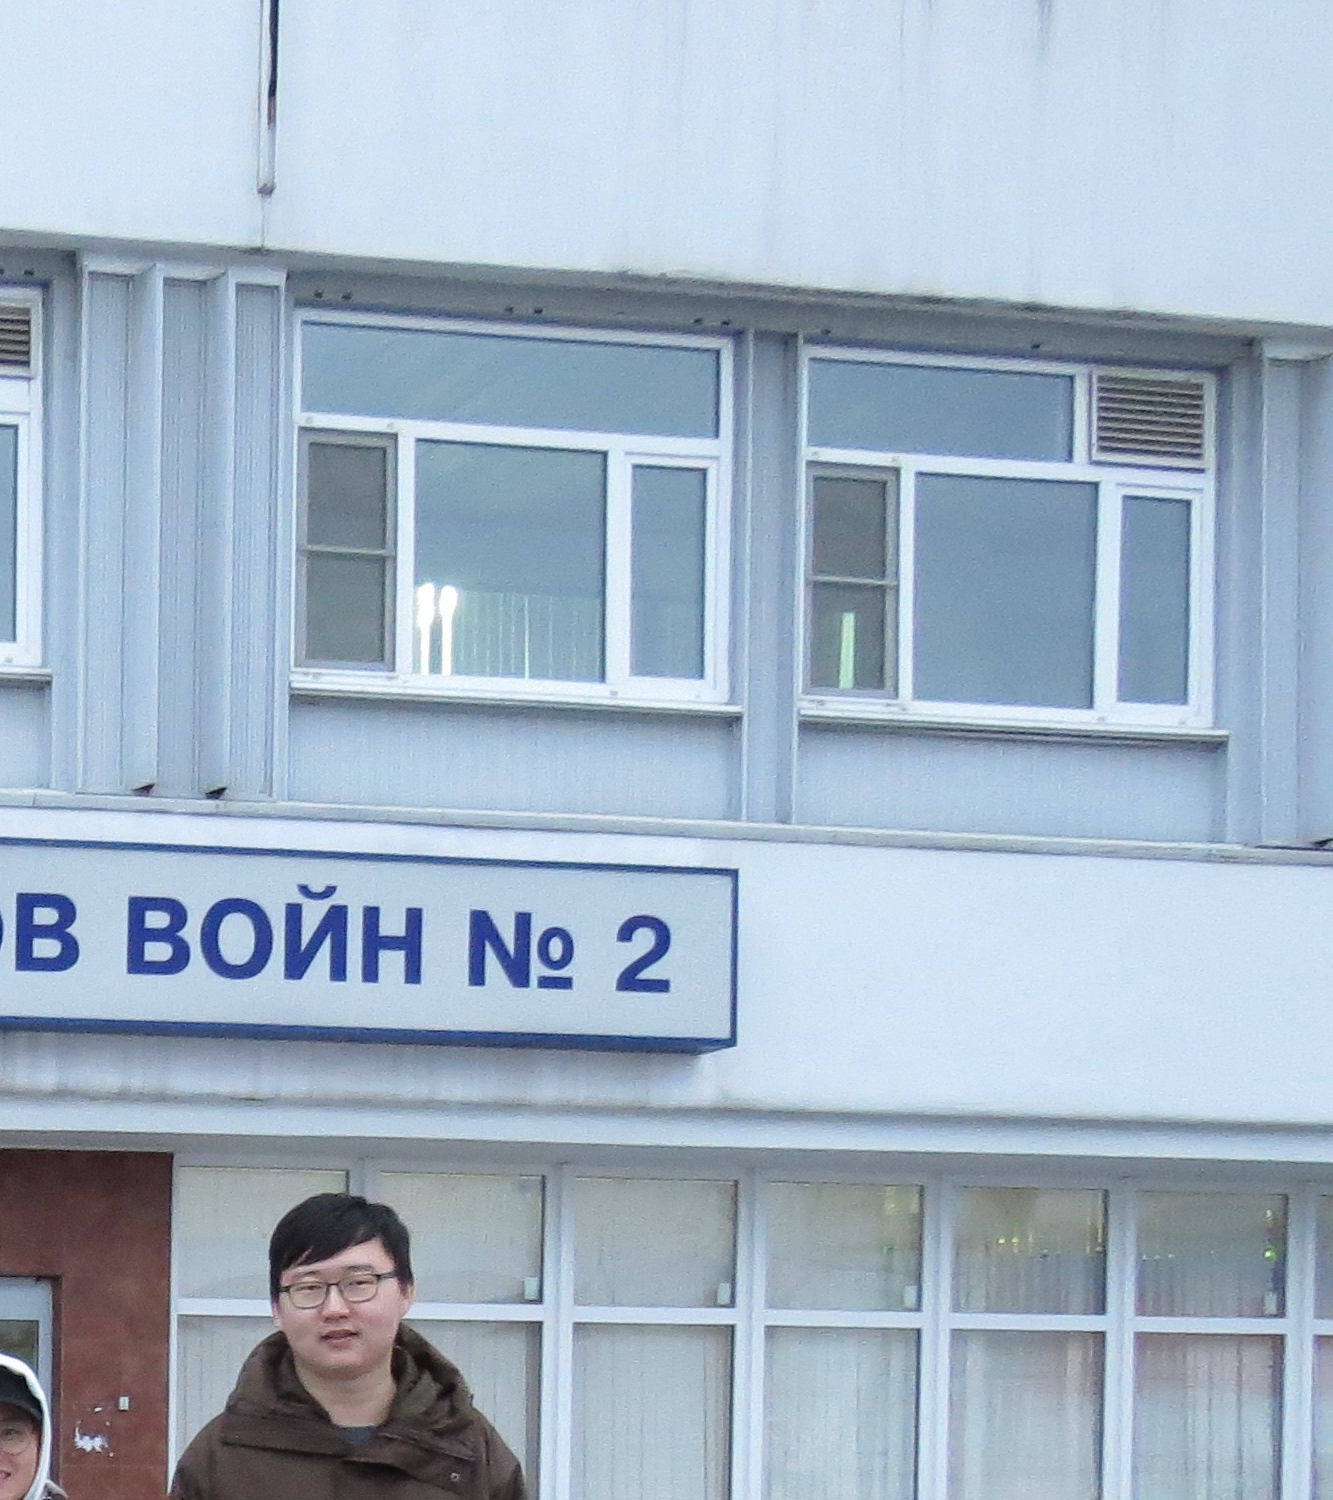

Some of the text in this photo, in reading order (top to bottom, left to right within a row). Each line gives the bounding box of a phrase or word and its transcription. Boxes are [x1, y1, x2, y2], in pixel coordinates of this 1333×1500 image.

[125, 883, 424, 986] ВОЙН
[467, 908, 576, 991] №
[615, 914, 673, 994] 2
